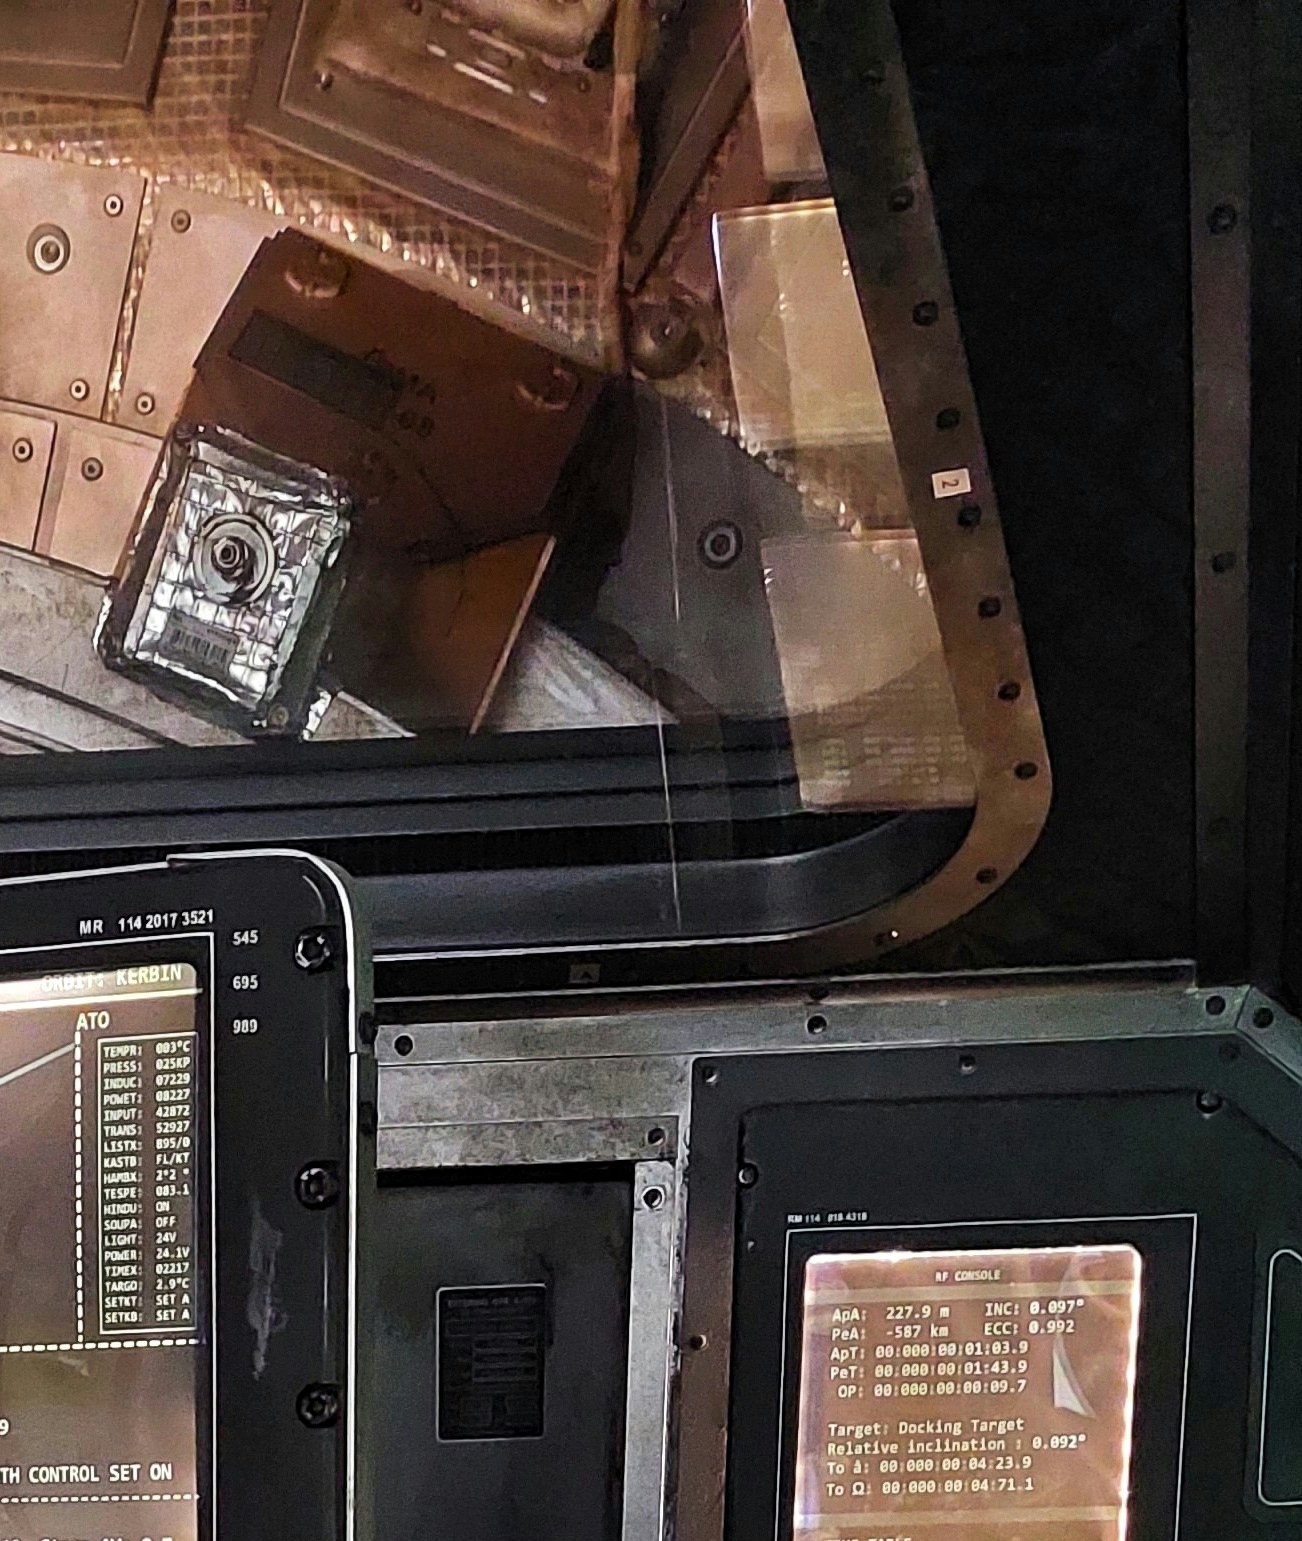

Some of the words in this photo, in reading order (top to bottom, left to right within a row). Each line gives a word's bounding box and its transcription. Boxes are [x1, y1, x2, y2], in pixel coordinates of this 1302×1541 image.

[941, 478, 960, 489] 2
[79, 919, 103, 935] MR
[118, 915, 141, 932] 114
[146, 913, 177, 930] 2017
[182, 910, 214, 927] 3521
[233, 930, 258, 945] 545
[116, 964, 181, 985] KERBIN
[233, 975, 258, 989] 695
[76, 1012, 109, 1030] ATO
[156, 1120, 190, 1134] 52927
[156, 1216, 176, 1227] OFF
[156, 1232, 176, 1244] 24V
[833, 1307, 866, 1323] ApA:
[886, 1306, 931, 1319] 227.9
[940, 1308, 949, 1317] m
[985, 1302, 1020, 1317] INC:
[828, 1422, 889, 1438] Target:
[899, 1419, 962, 1435] Docking
[971, 1418, 1025, 1433] Target
[29, 1465, 99, 1483] CONTROL
[110, 1464, 139, 1481] SET
[149, 1463, 173, 1480] ON
